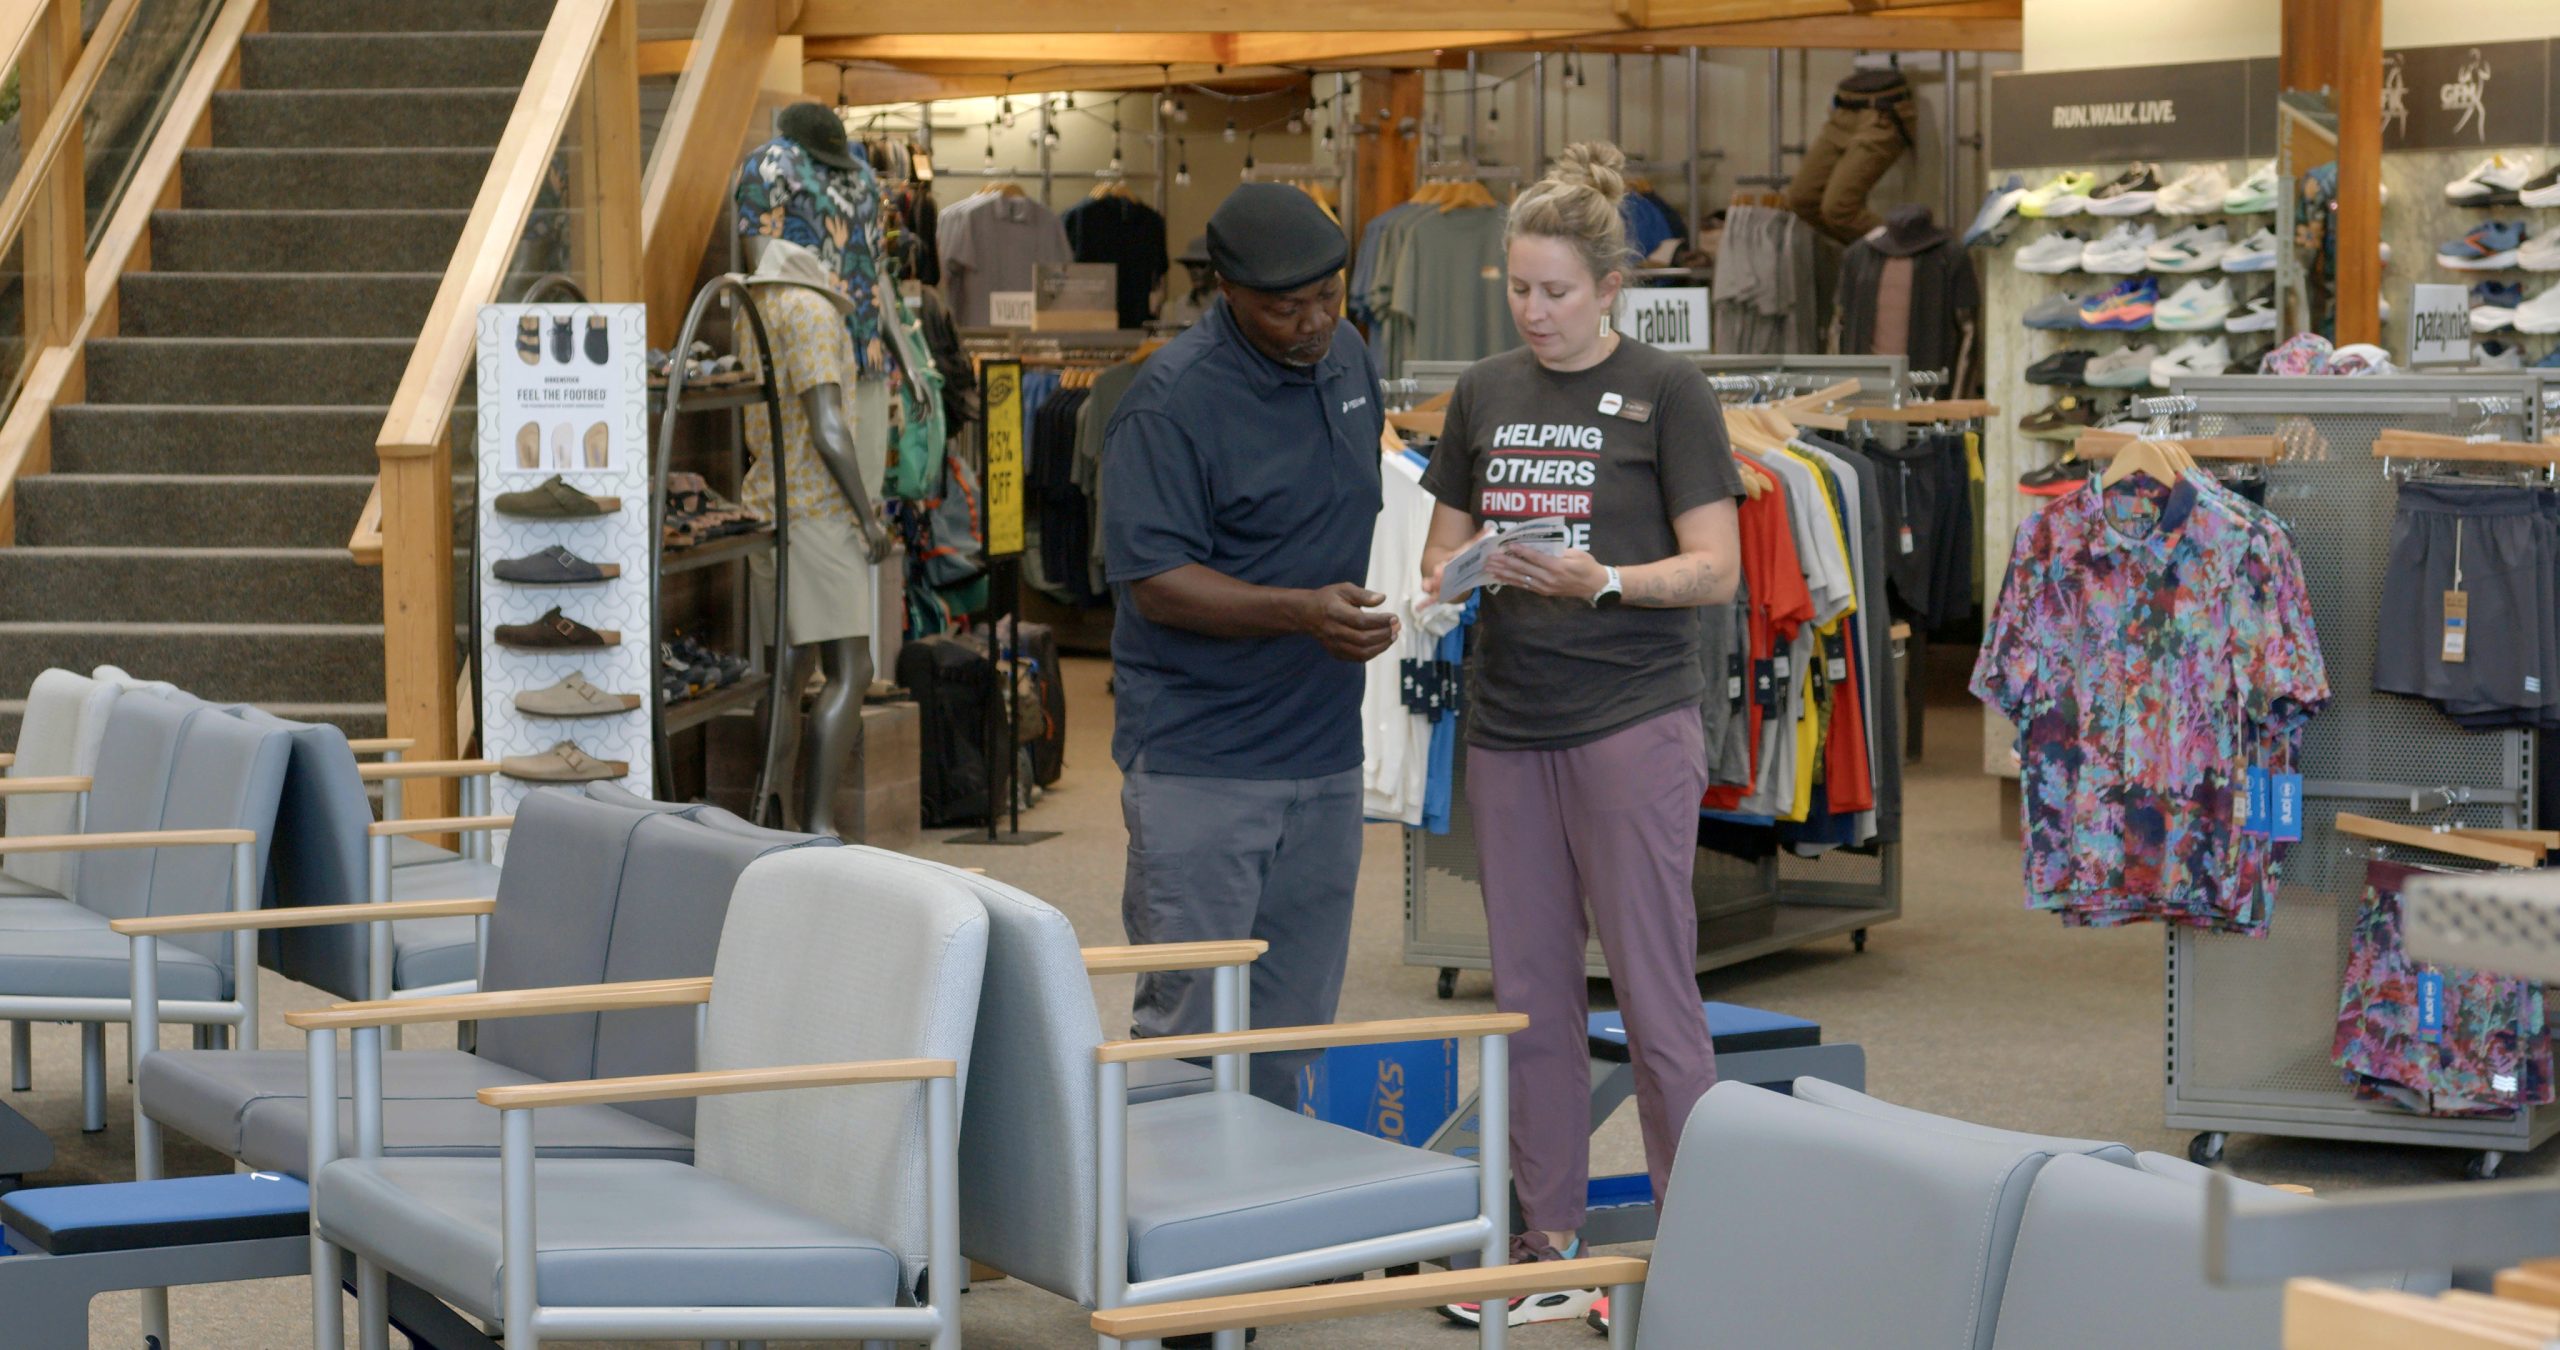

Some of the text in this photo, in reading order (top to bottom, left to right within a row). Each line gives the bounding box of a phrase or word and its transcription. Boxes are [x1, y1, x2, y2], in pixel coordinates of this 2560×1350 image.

[1636, 299, 1690, 343] rabbit
[517, 388, 607, 401] FEEL THE FOOTBED
[1493, 423, 1604, 450] HELPING
[1486, 458, 1596, 486] OTHERS
[990, 472, 1012, 505] OFF
[1481, 492, 1591, 515] FIND THEIR
[1378, 1059, 1405, 1143] OKS
